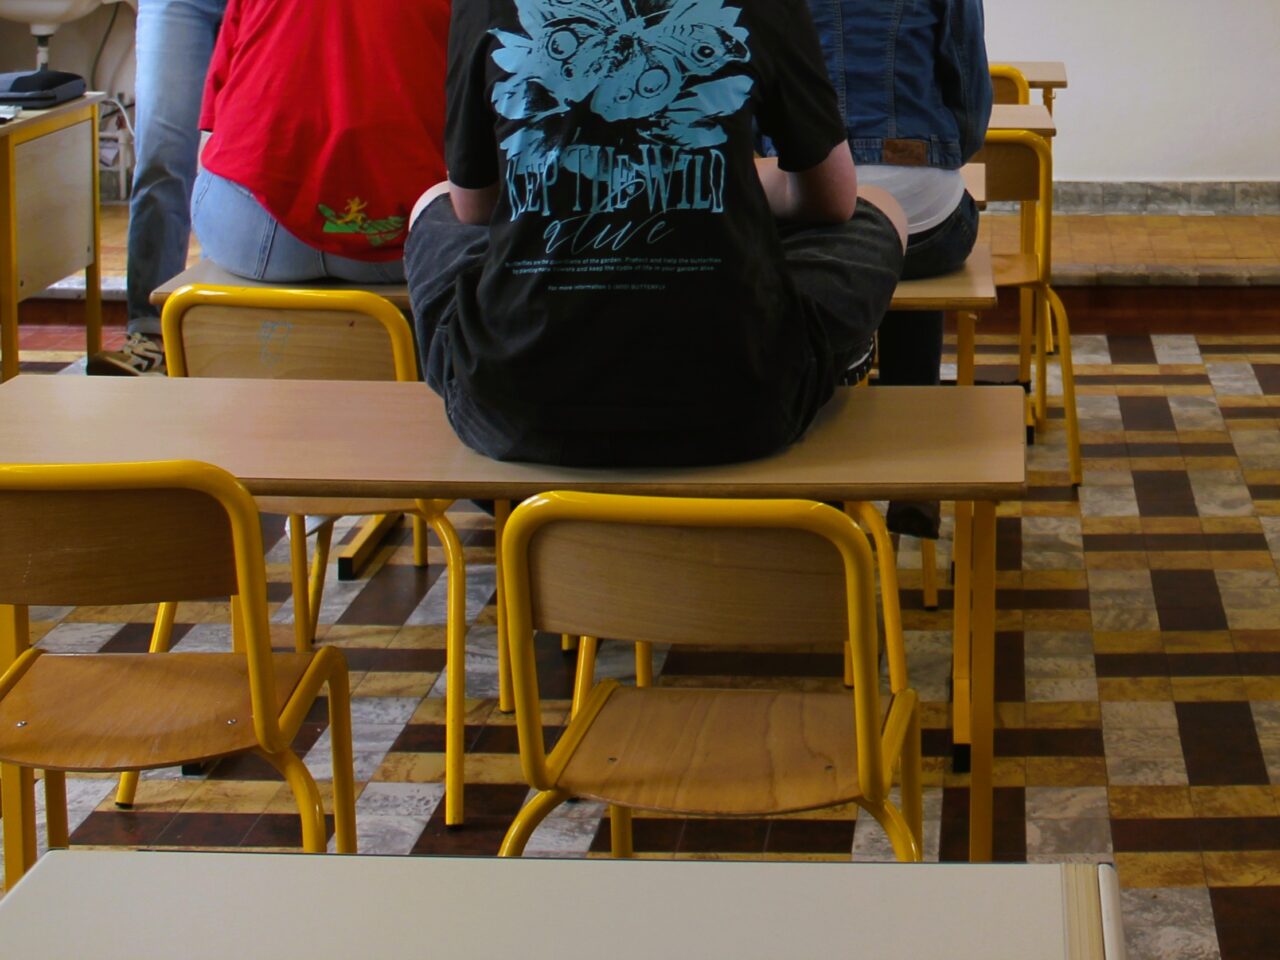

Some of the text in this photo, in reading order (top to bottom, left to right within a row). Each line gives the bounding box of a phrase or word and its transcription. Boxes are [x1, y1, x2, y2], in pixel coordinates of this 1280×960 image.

[506, 143, 726, 222] KEEP THE WILD
